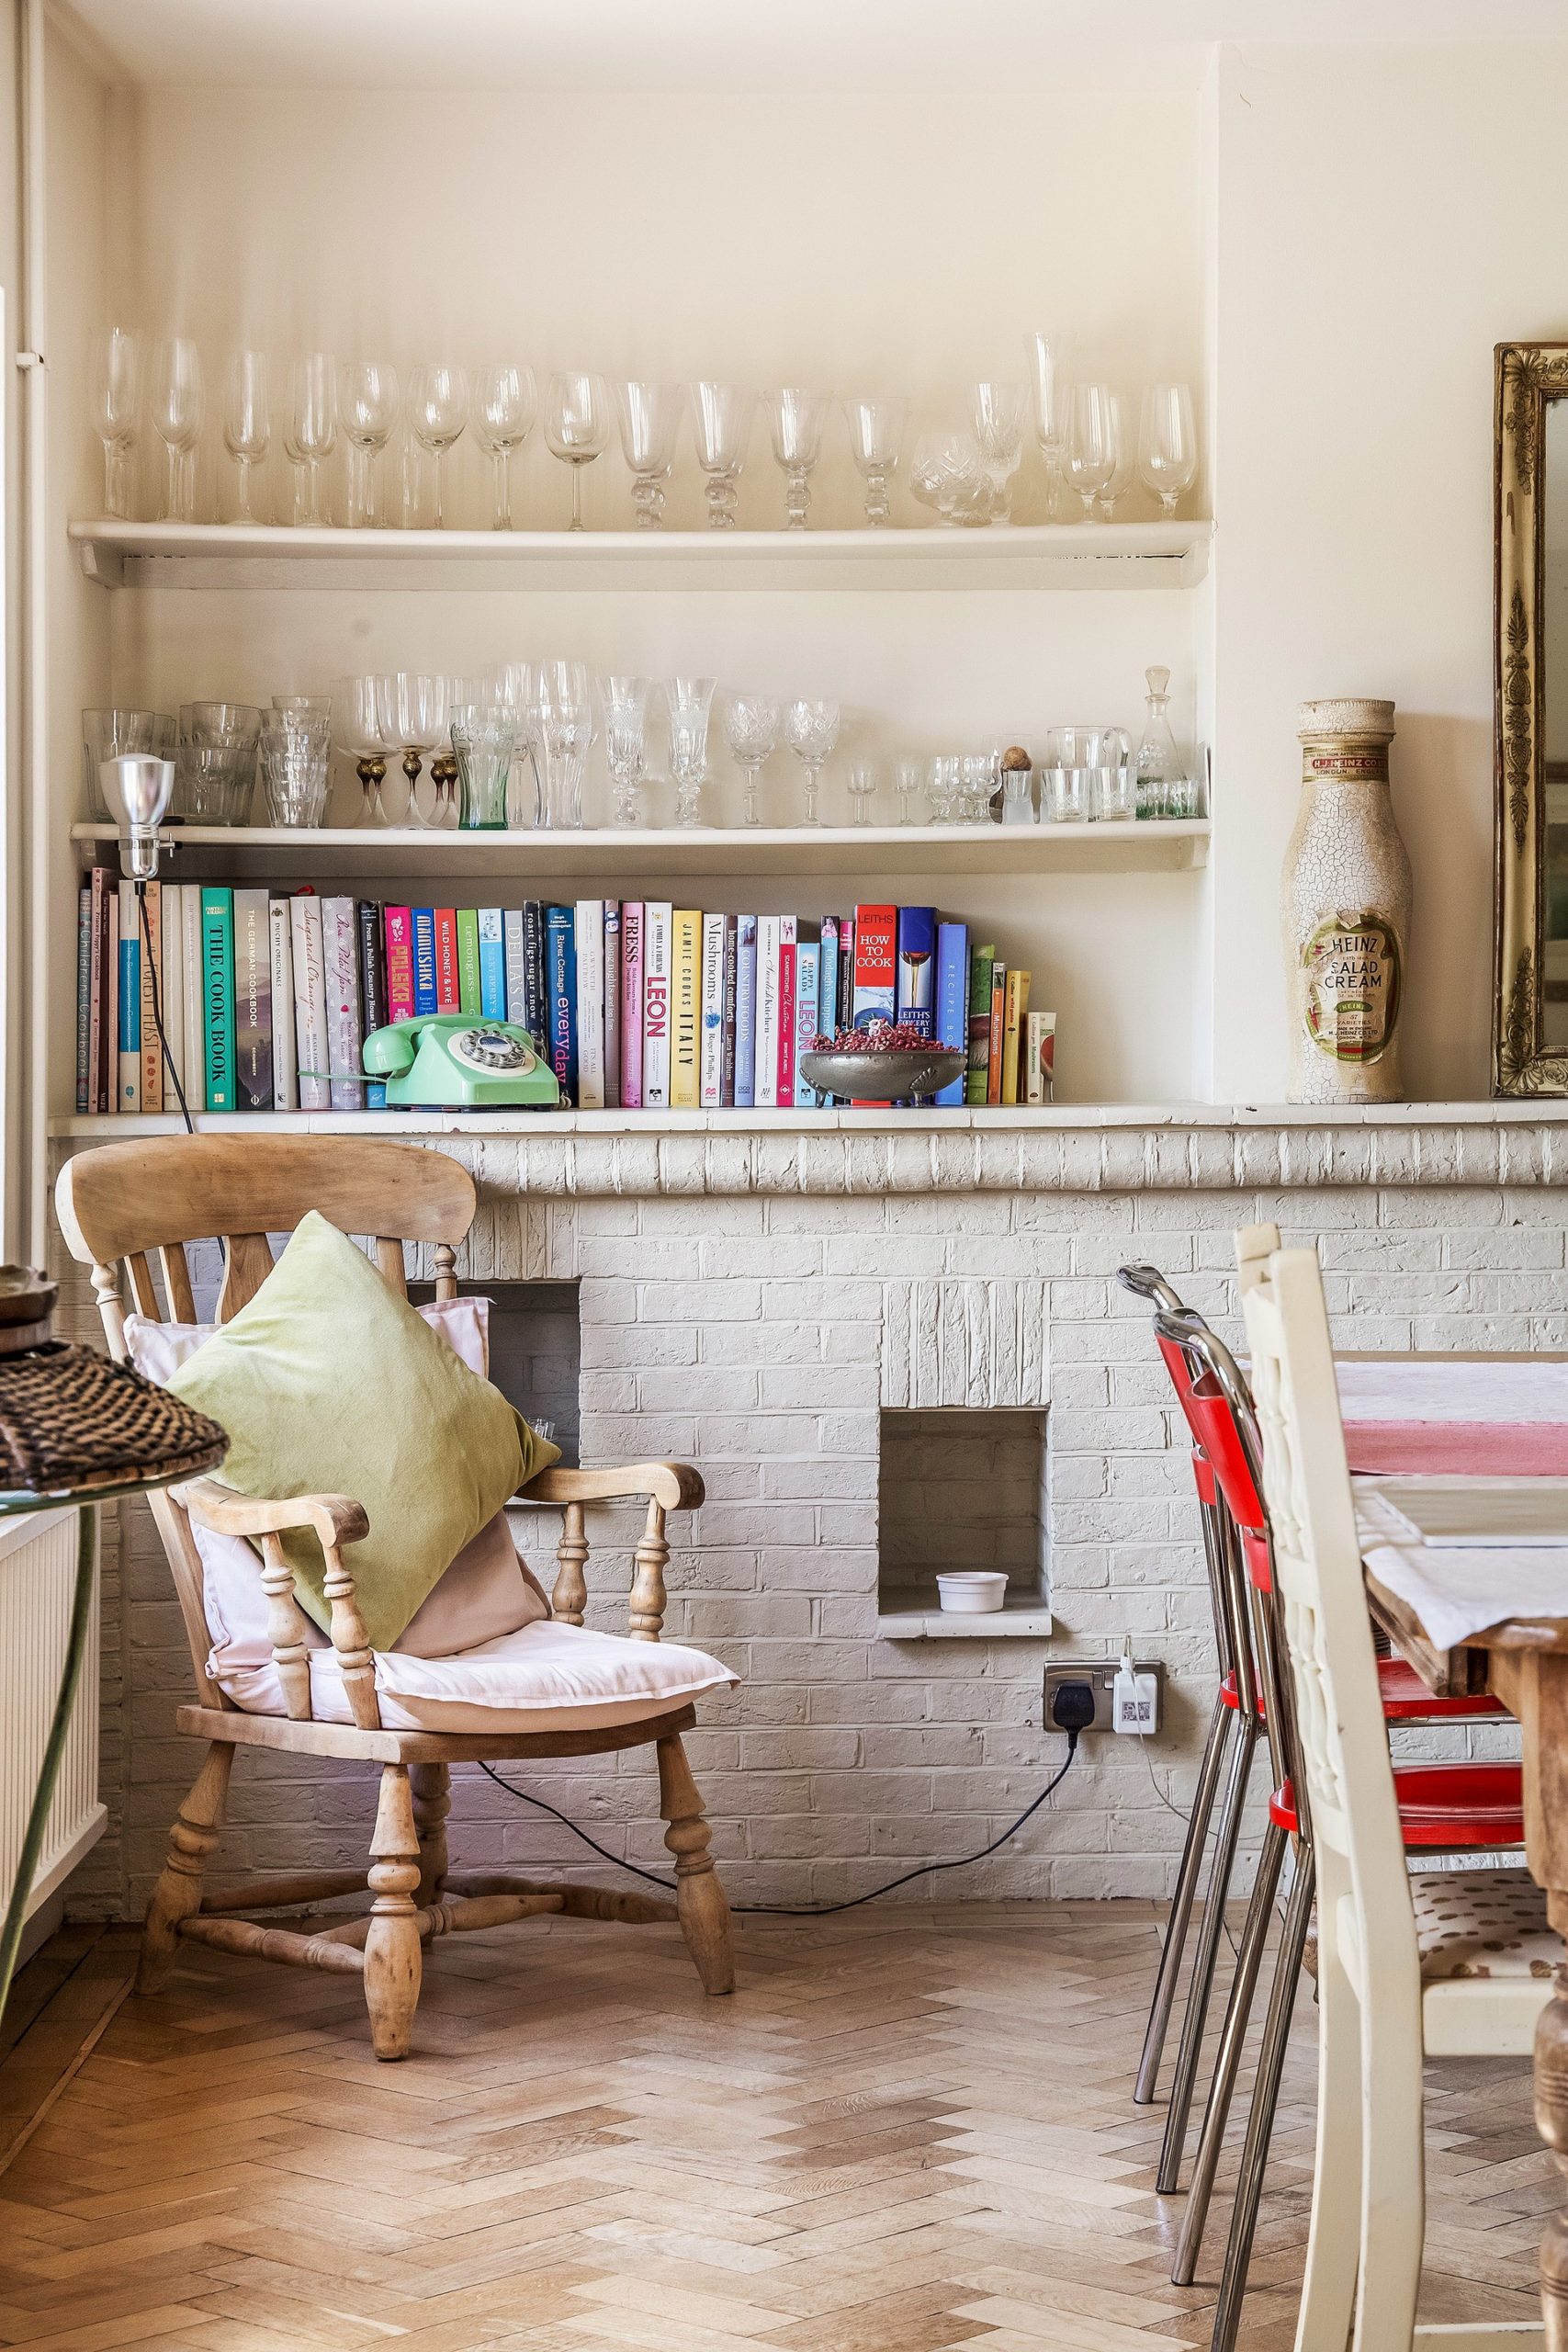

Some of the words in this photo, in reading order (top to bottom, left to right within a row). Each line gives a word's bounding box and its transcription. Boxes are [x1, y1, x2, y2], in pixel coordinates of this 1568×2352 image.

[296, 904, 320, 965] Sugared
[336, 913, 349, 939] Rose
[442, 921, 450, 943] WILD
[527, 913, 536, 938] roast
[858, 915, 894, 924] LEITHS
[209, 924, 224, 966] THE
[248, 930, 256, 970] GERMAN
[336, 944, 351, 970] Petal
[417, 915, 434, 990] MAMUSHKA
[526, 942, 536, 959] figs
[557, 934, 565, 957] River
[607, 941, 617, 962] long
[625, 915, 639, 963] FRESS
[682, 924, 692, 960] JAMIE
[727, 930, 735, 985] home-cooked
[860, 935, 890, 944] HOW
[865, 946, 884, 956] TO
[1332, 937, 1378, 954] HEINZ
[390, 944, 410, 1001] POLSKA
[465, 925, 475, 991] Lemongrass
[507, 926, 524, 994] DELIA'S
[527, 963, 536, 990] sugar
[557, 958, 566, 993] Cottage
[707, 921, 722, 1000] Mushrooms
[741, 950, 750, 1001] COUNTRY
[823, 948, 834, 992] Clodagh's
[856, 957, 893, 967] COOK
[1331, 961, 1378, 974] SALAD
[143, 963, 158, 1004] FOREST
[209, 970, 225, 1023] COOK
[299, 967, 320, 1011] Orange
[332, 967, 352, 995] Jam
[367, 970, 376, 999] Country
[606, 964, 617, 993] nights
[682, 968, 692, 1005] COOKS
[764, 959, 775, 999] Swedish
[1325, 976, 1382, 989] CREAM
[249, 974, 257, 1027] COOKBOOK
[368, 1000, 377, 1021] House
[607, 1008, 615, 1018] log
[647, 977, 667, 1037] LEON
[726, 987, 735, 1023] comforts
[764, 1000, 773, 1033] Kitchen
[782, 993, 792, 1034] Christmas
[821, 994, 834, 1034] Suppers
[79, 1003, 90, 1074] Cookbook
[143, 1013, 158, 1049] FEAST
[555, 997, 570, 1084] everyday
[680, 1014, 693, 1066] ITALY
[740, 1005, 750, 1042] FOODS
[799, 1000, 815, 1050] LEON
[992, 1013, 1000, 1055] Mushrooms
[211, 1029, 226, 1082] BOOK
[707, 1033, 716, 1054] Roger
[707, 1055, 716, 1080] Phillips
